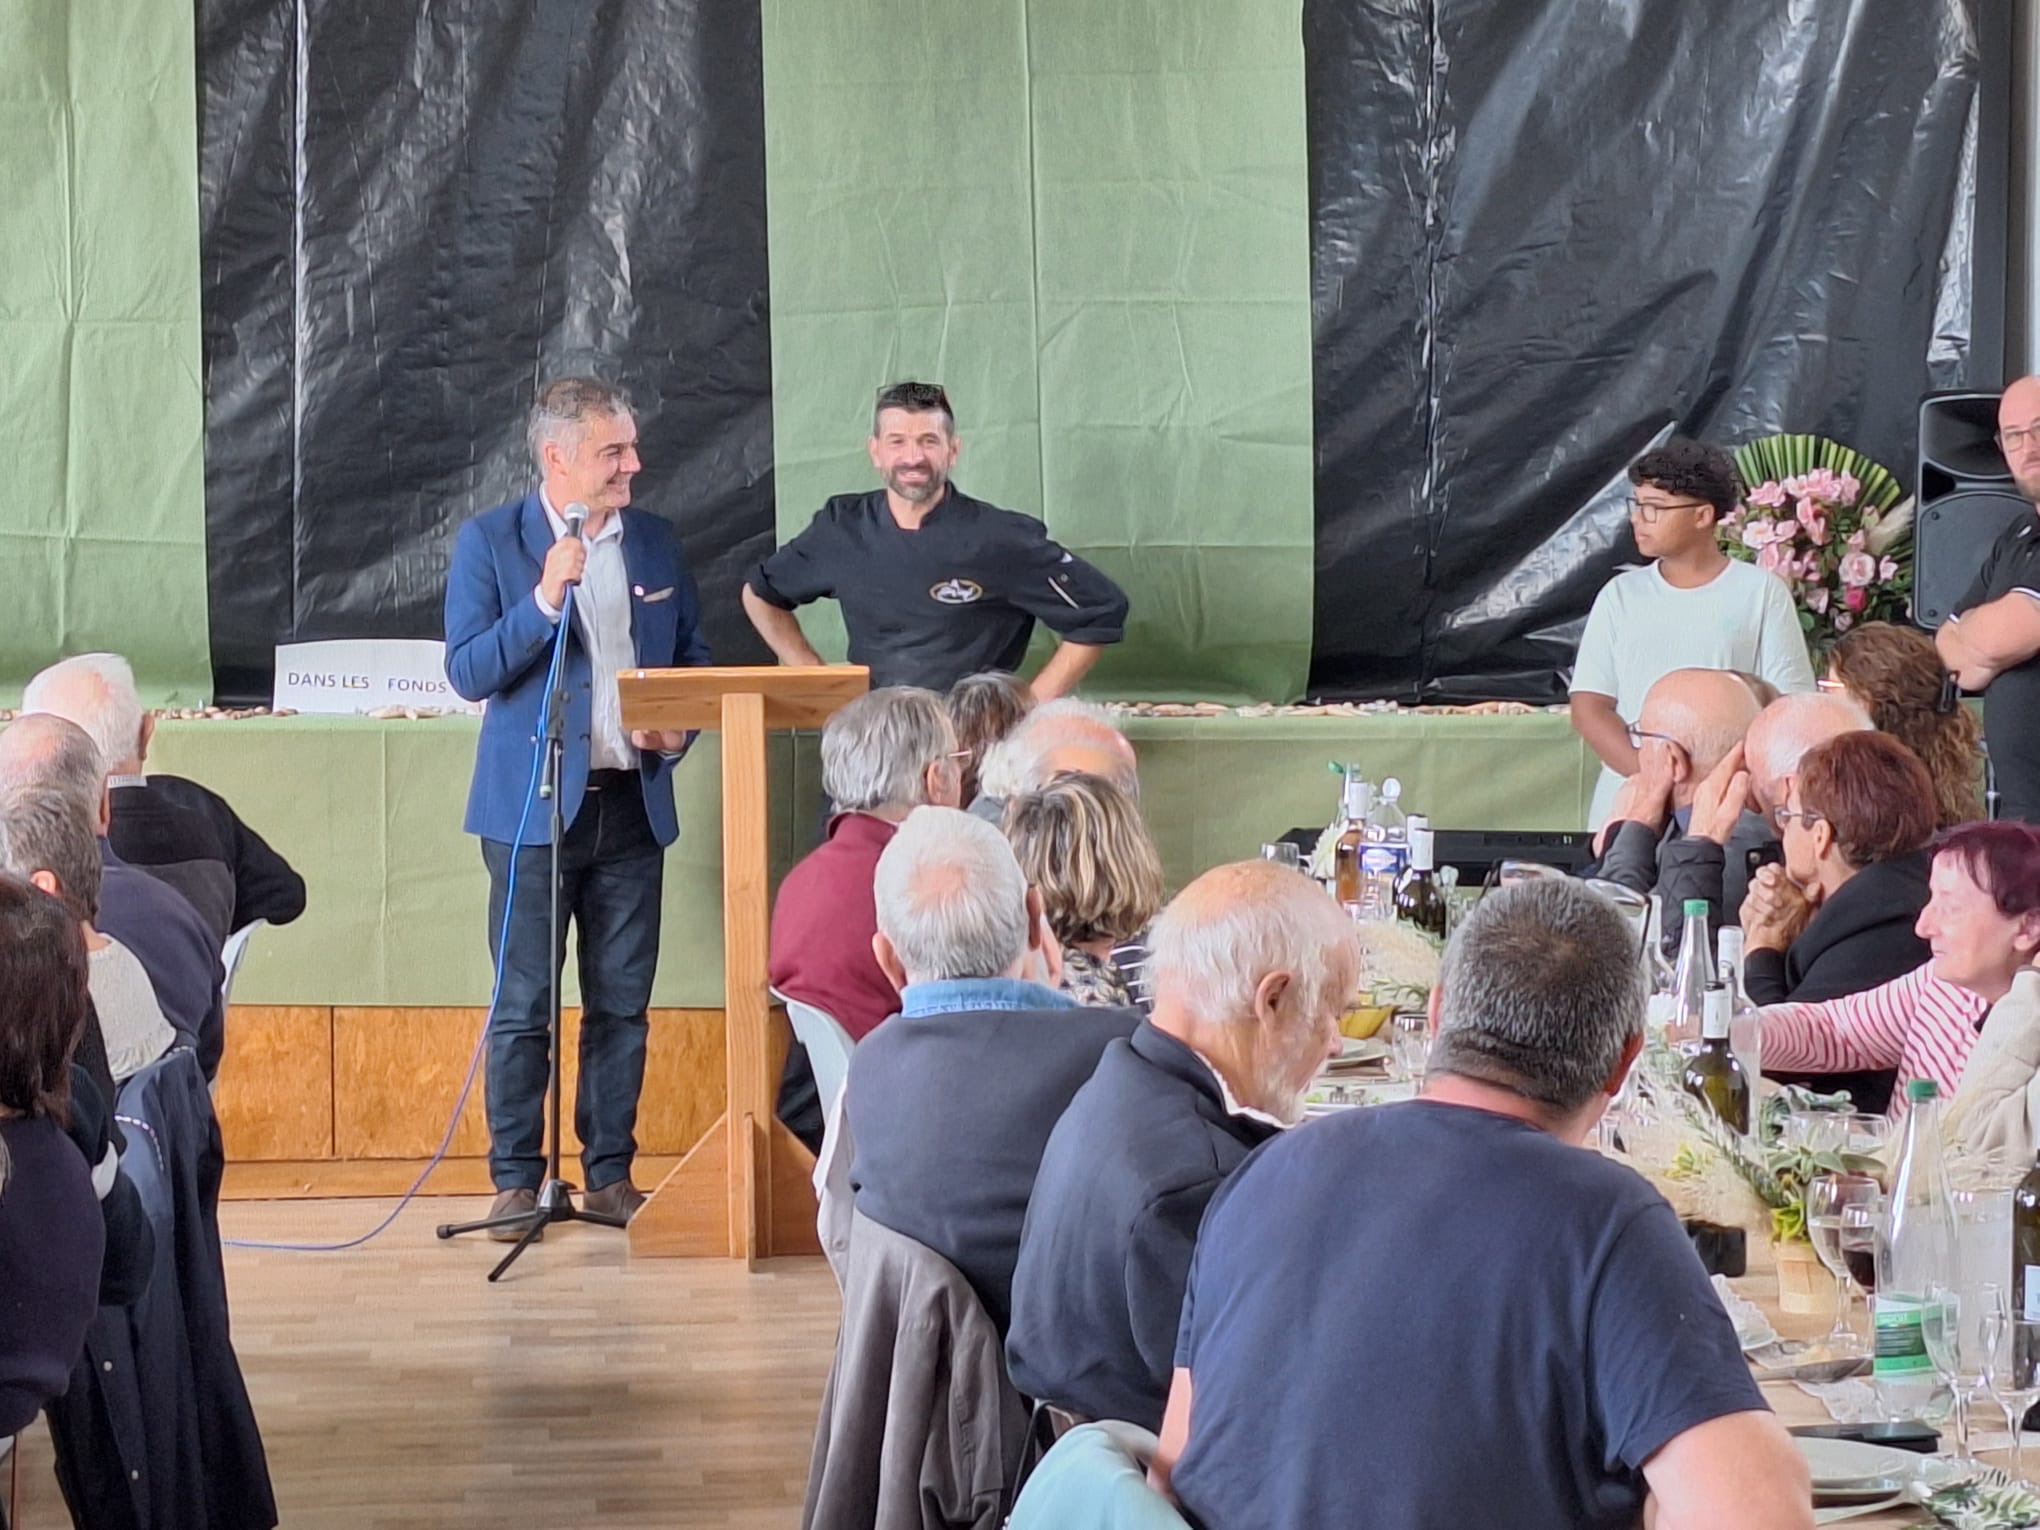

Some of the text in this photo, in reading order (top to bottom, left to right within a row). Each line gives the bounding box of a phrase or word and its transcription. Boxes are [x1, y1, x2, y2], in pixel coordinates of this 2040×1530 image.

[287, 671, 447, 693] DANS LES FONDS
